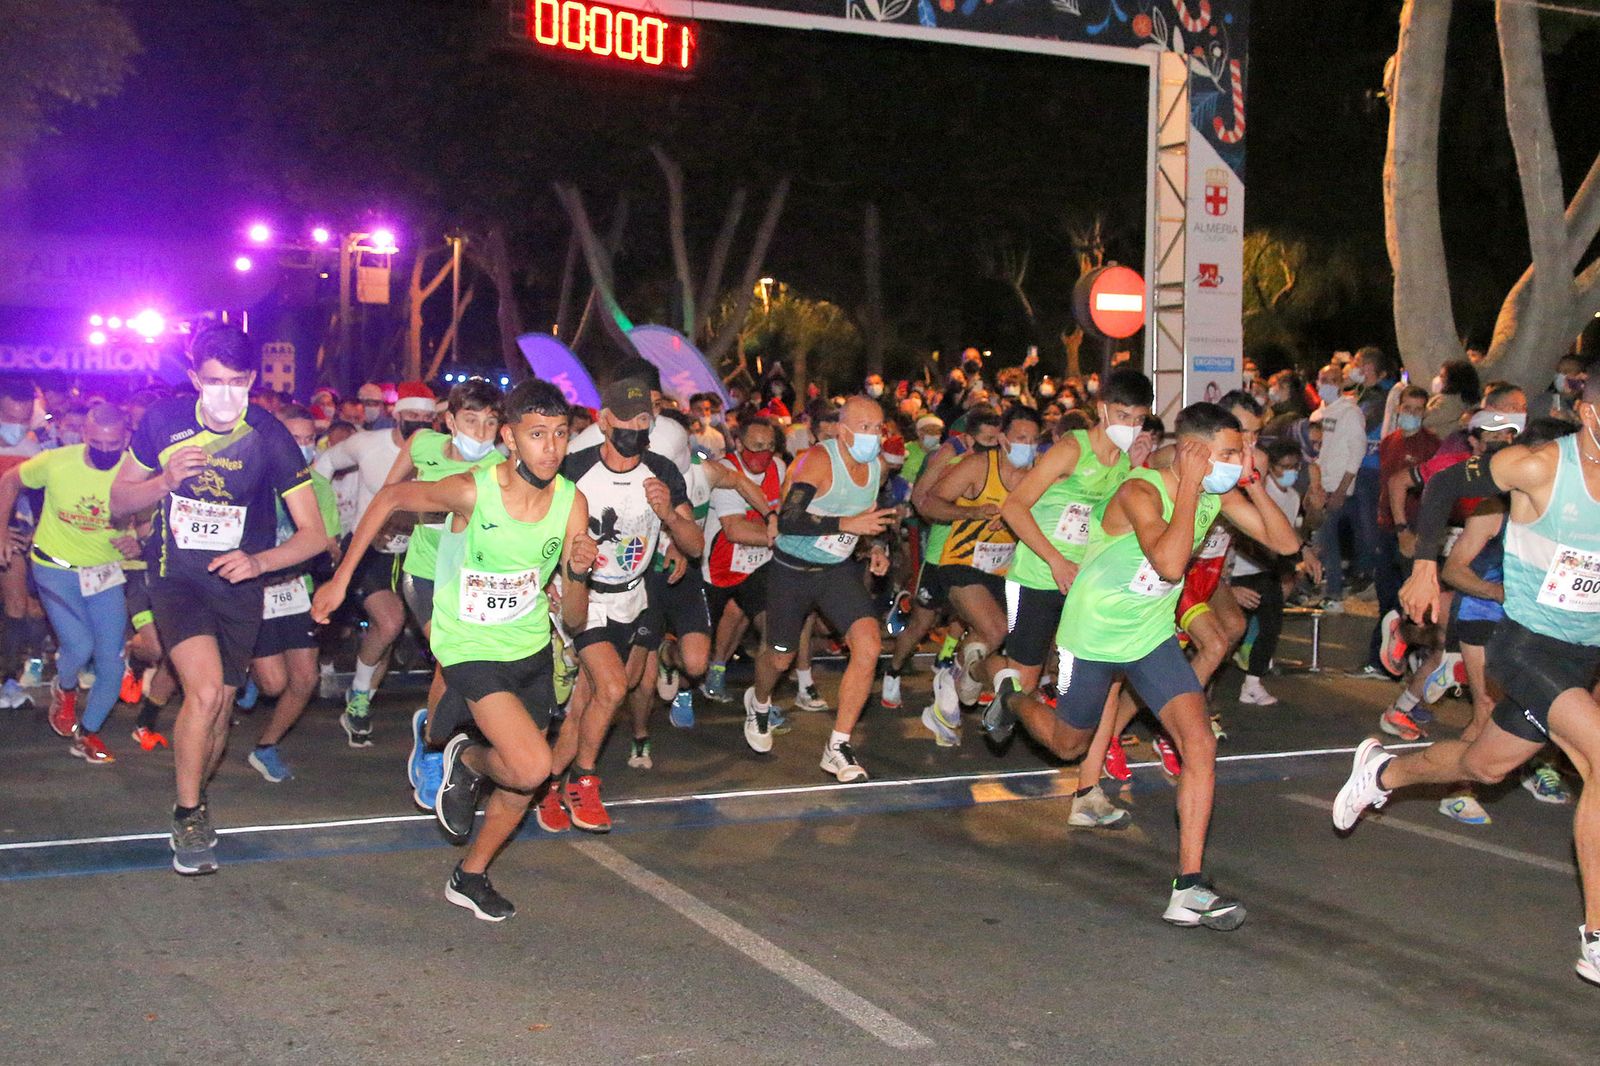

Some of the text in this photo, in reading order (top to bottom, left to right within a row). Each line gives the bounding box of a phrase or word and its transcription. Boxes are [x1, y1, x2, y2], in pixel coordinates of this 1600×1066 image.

[191, 522, 219, 535] 812
[271, 591, 293, 604] 768
[486, 596, 517, 609] 875
